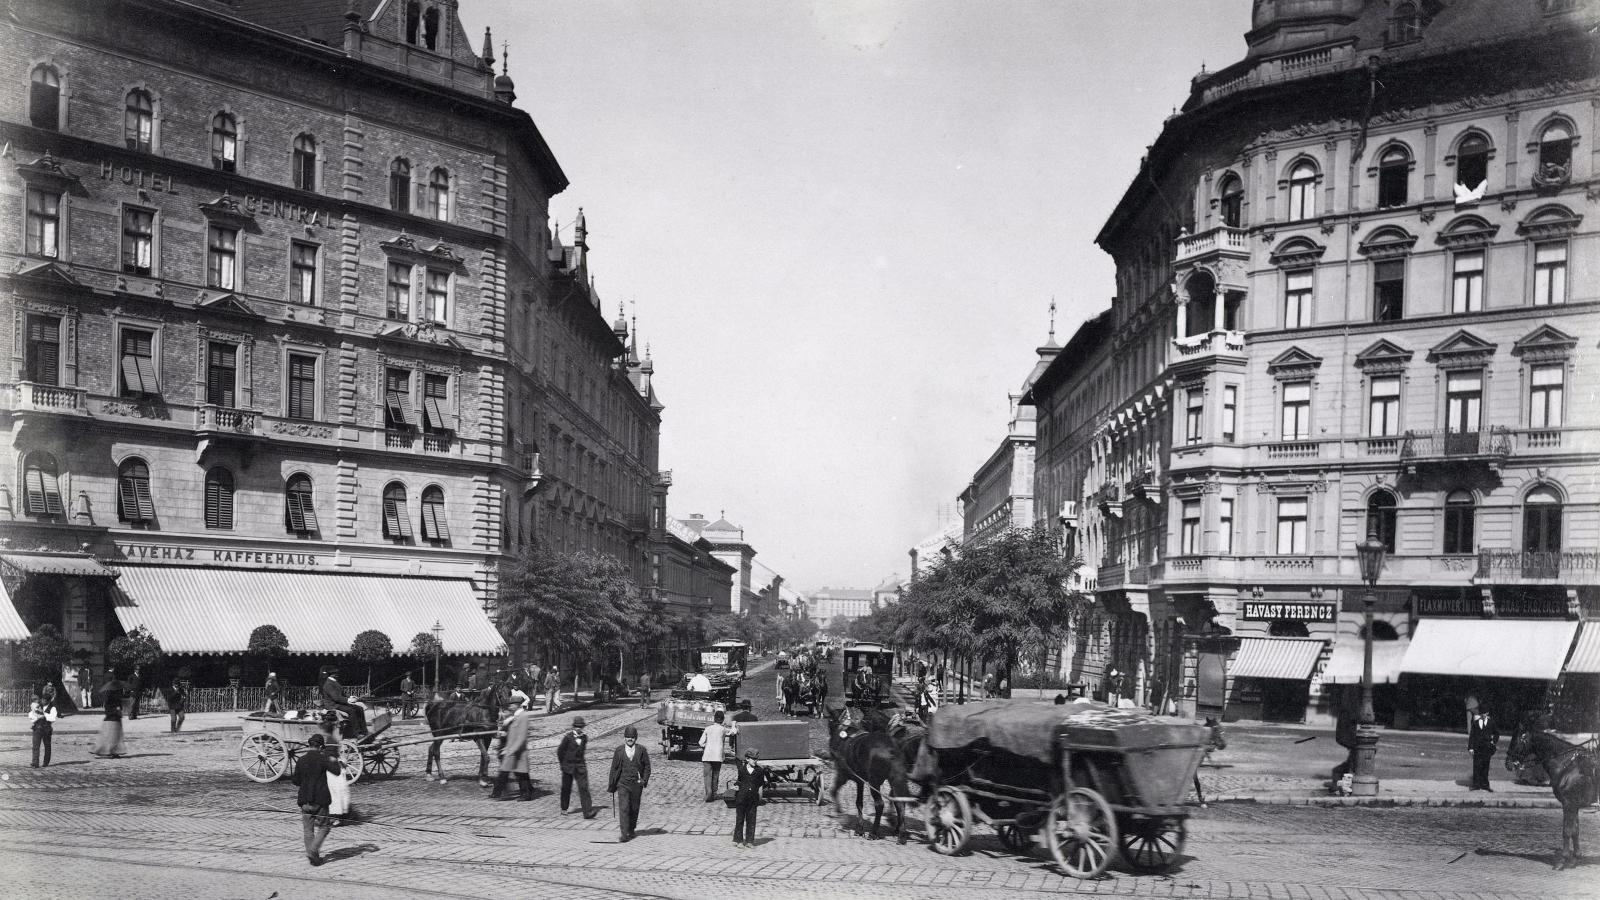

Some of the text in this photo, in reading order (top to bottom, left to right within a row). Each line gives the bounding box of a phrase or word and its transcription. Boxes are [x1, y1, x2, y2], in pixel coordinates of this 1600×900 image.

[101, 160, 178, 194] HOTEL
[214, 550, 319, 566] KAFFEEHAUS.
[1246, 604, 1332, 619] HAVASY FERENCZ
